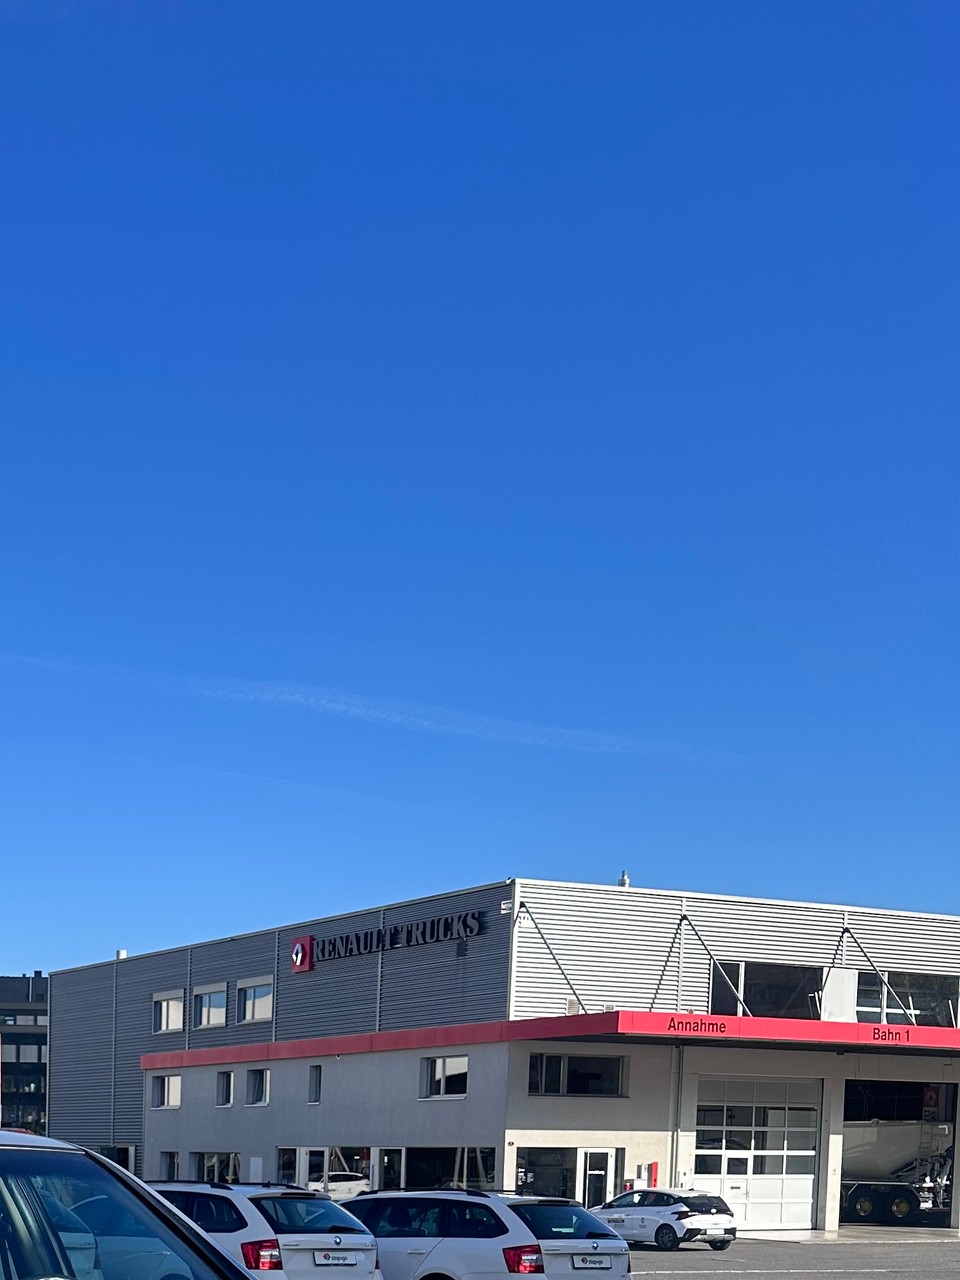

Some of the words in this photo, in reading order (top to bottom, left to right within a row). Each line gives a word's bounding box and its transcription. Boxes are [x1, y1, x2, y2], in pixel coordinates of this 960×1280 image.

[313, 926, 395, 962] RENAULT
[398, 910, 480, 948] TRUCKS
[667, 1017, 727, 1034] Annahme
[872, 1027, 902, 1042] Bahn
[904, 1029, 911, 1042] 1
